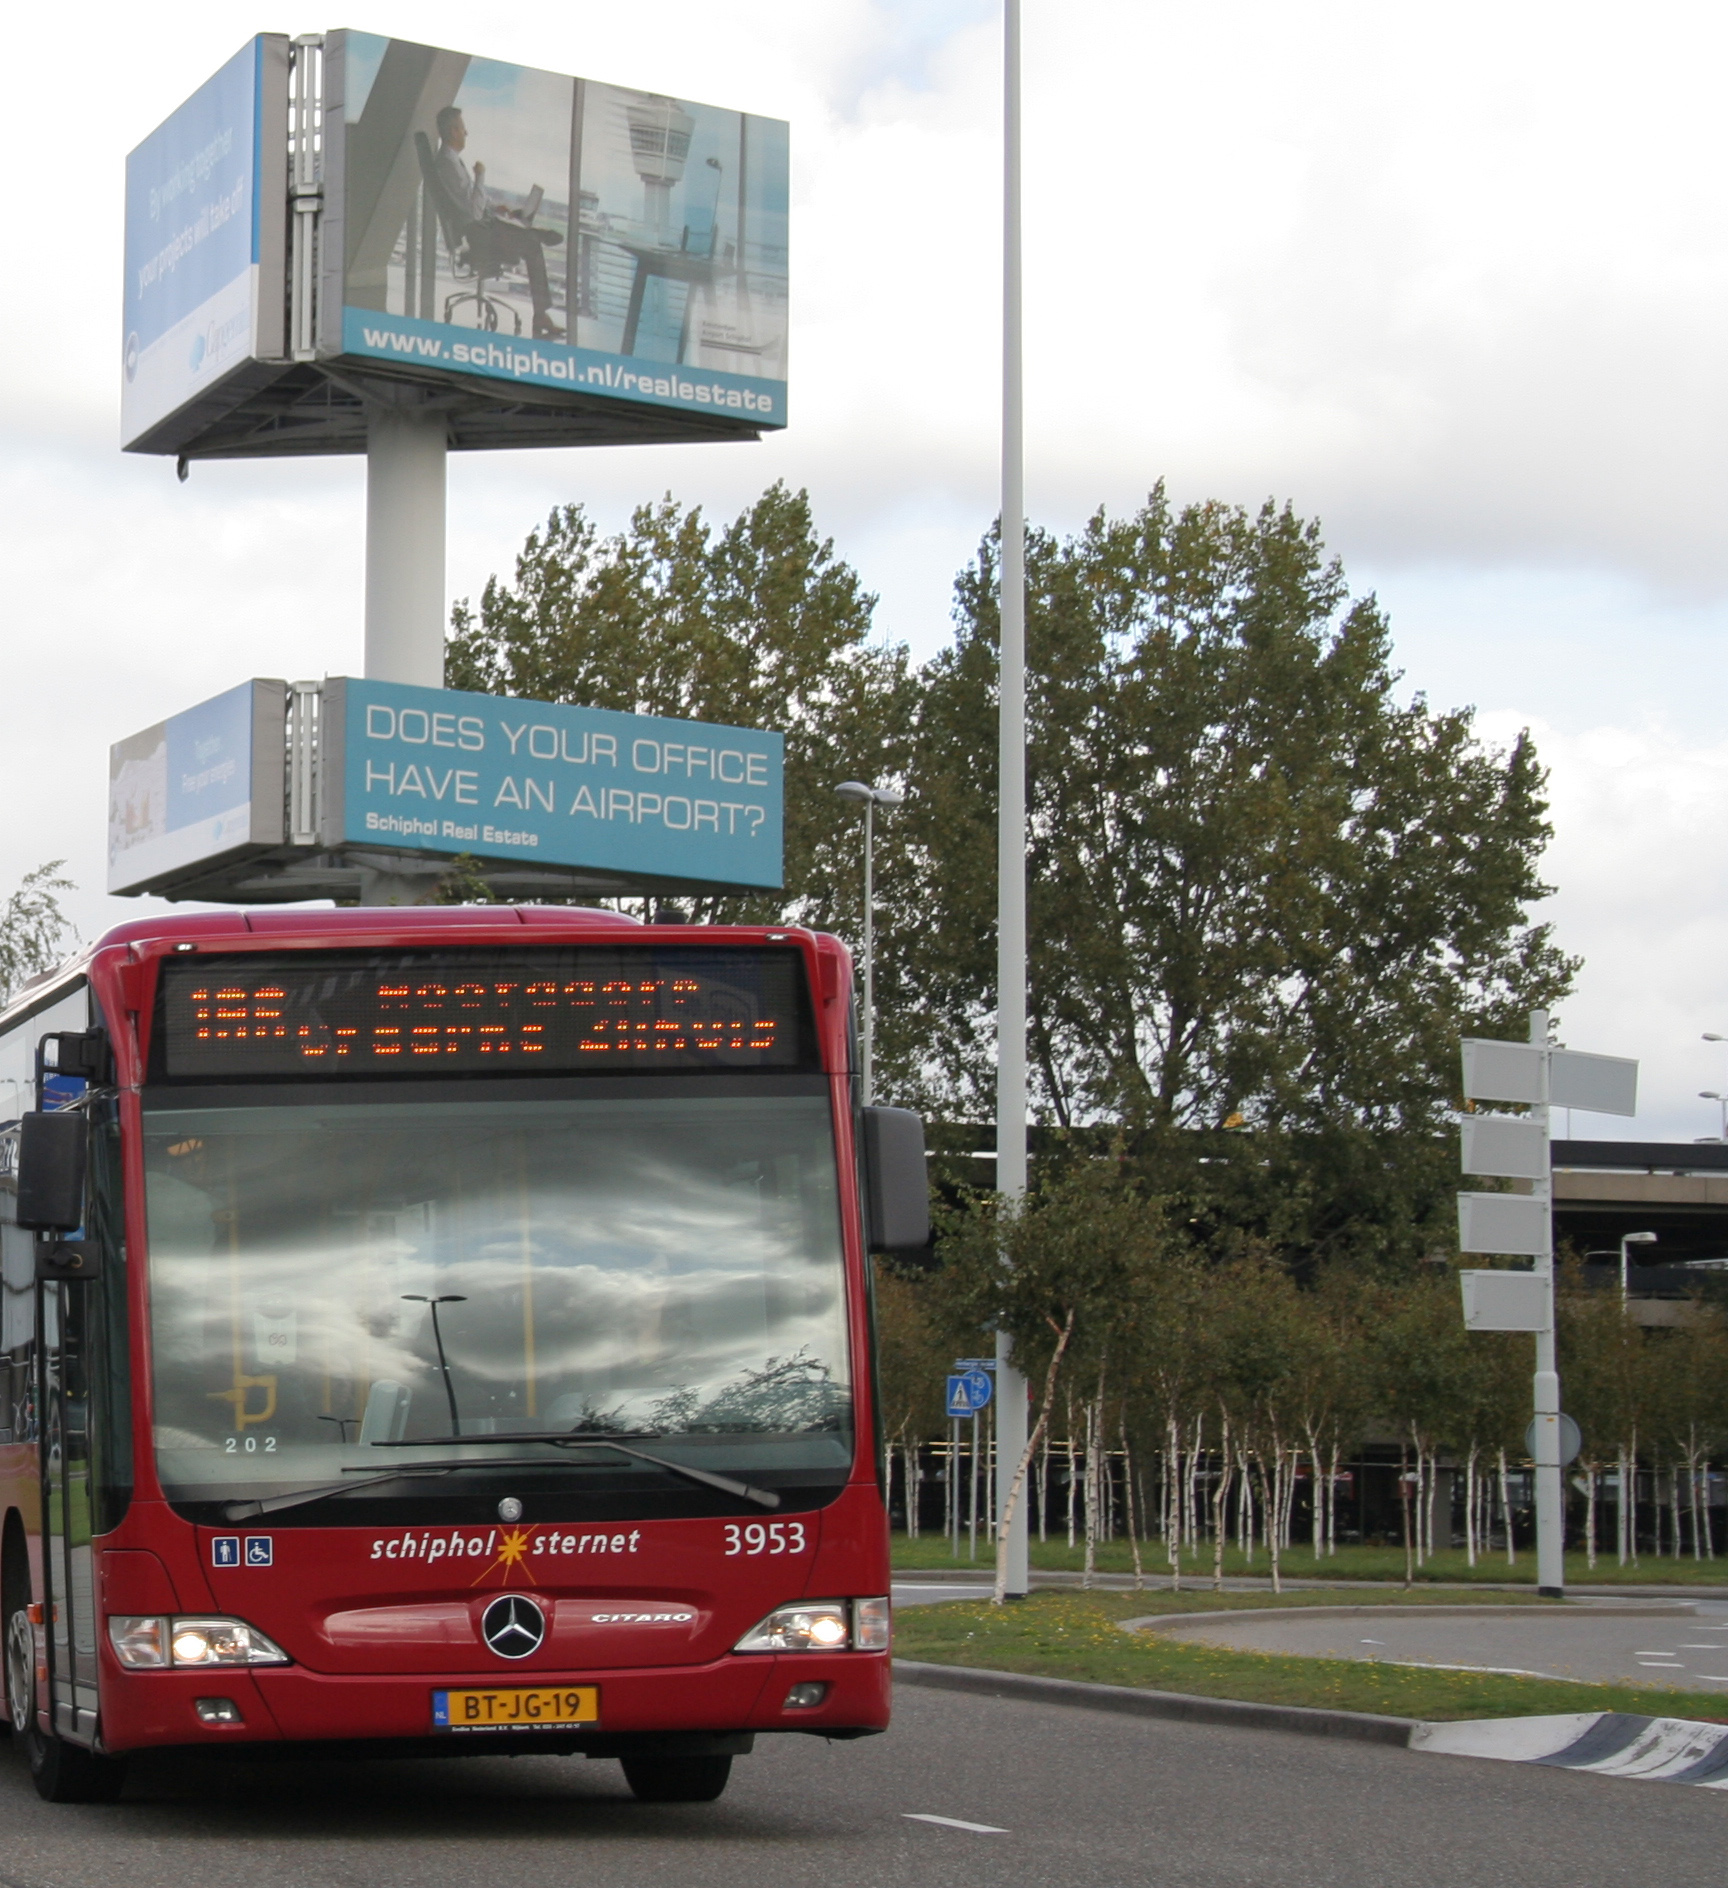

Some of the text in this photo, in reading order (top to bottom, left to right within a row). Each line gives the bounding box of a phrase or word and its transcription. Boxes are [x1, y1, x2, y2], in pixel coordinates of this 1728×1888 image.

[362, 326, 773, 413] www.schiphol.nl/realestate
[366, 703, 769, 787] DOES YOUR OFFICE
[366, 759, 766, 838] HAVE AN AIRPORT?
[365, 812, 539, 847] Schiphol Real Estate
[225, 1436, 277, 1453] 202
[370, 1522, 808, 1564] schiphol sternet 3953
[590, 1612, 694, 1625] CITARO
[435, 1692, 581, 1720] NL BT-JG-19
